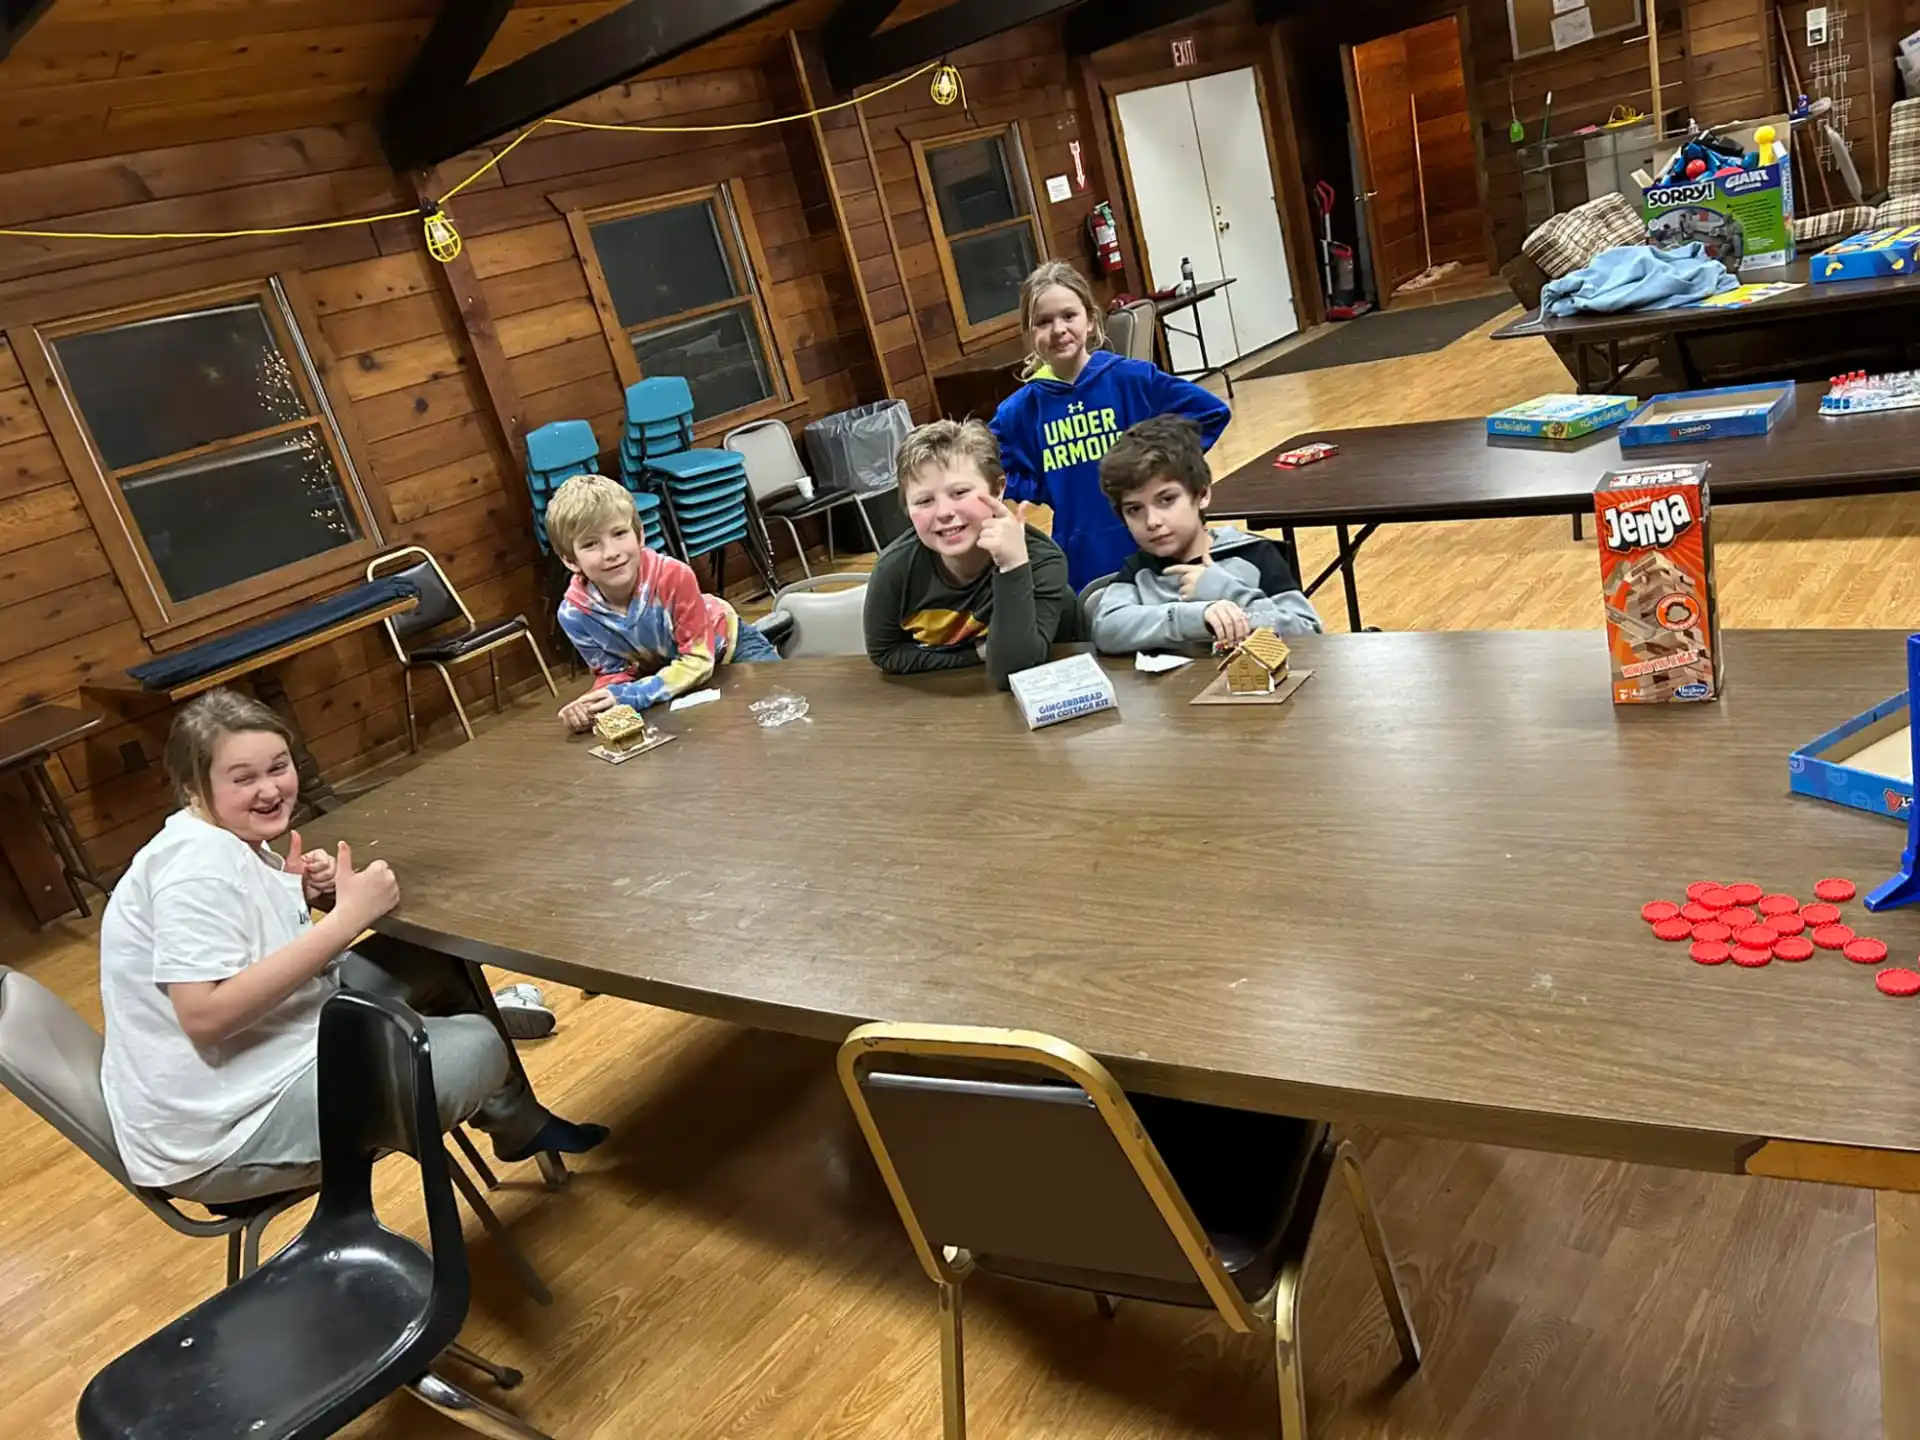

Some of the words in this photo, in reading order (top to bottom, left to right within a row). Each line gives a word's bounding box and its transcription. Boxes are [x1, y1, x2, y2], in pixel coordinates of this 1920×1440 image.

[1172, 40, 1193, 66] EXIT
[1725, 170, 1769, 188] GIANT
[1648, 181, 1715, 208] SORRY!
[1043, 407, 1118, 446] UNDER
[1604, 493, 1692, 548] Jenga
[1035, 712, 1057, 723] MINI
[1056, 702, 1094, 718] COTTAGE
[1095, 698, 1109, 710] KIT
[1038, 692, 1103, 714] GINGERBREAD
